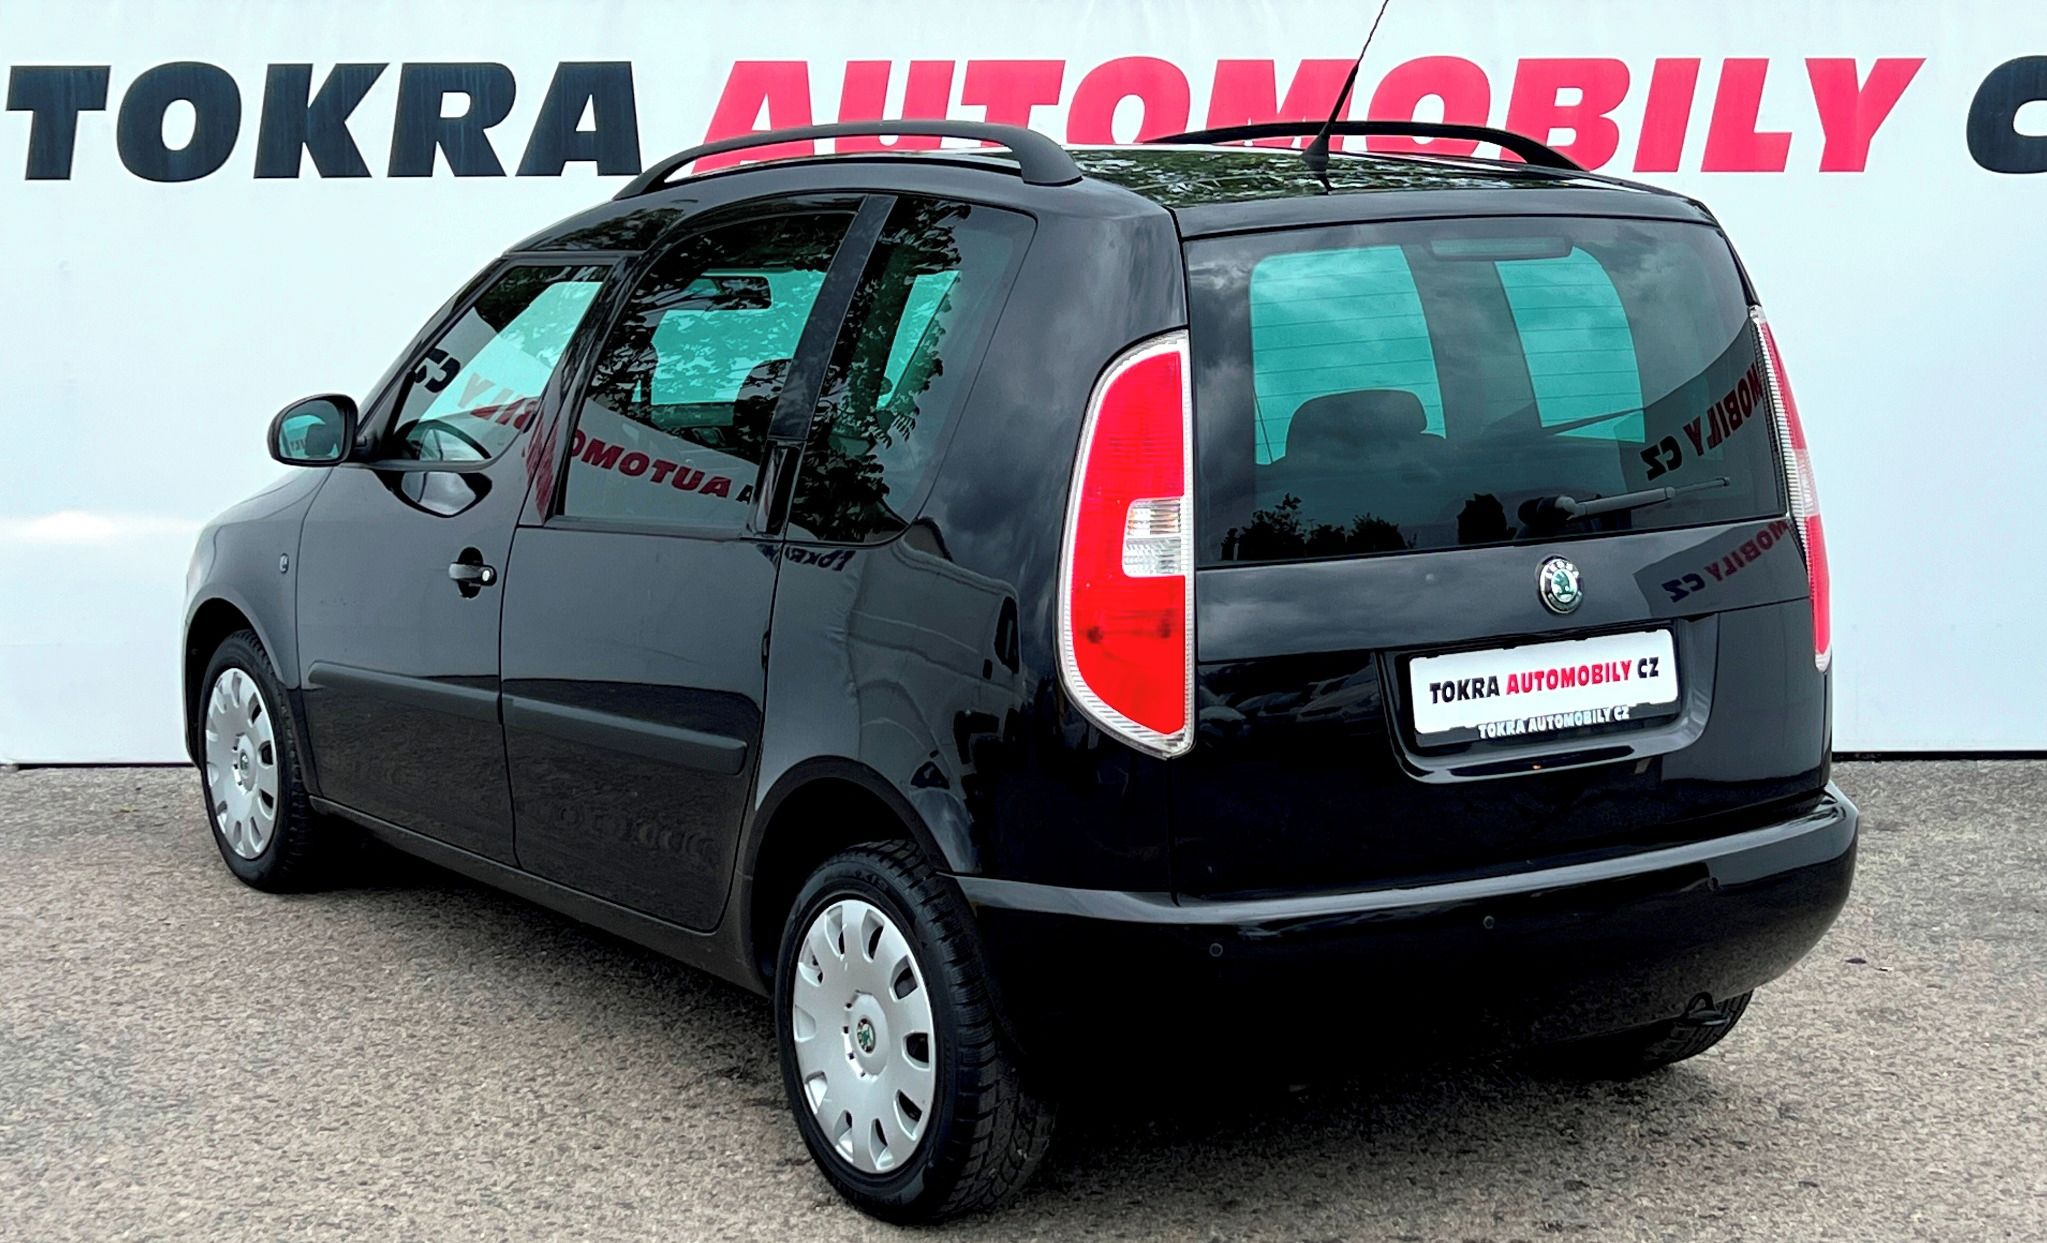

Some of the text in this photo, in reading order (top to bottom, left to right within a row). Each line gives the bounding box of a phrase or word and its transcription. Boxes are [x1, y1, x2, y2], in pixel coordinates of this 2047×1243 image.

[6, 61, 642, 182] TOKRA
[691, 56, 1926, 175] AUTOMOBILY
[1429, 656, 1659, 704] TOKRA AUTOMOBILY CZ
[1478, 704, 1630, 740] TOKRA AUTOMOBILY CZ
